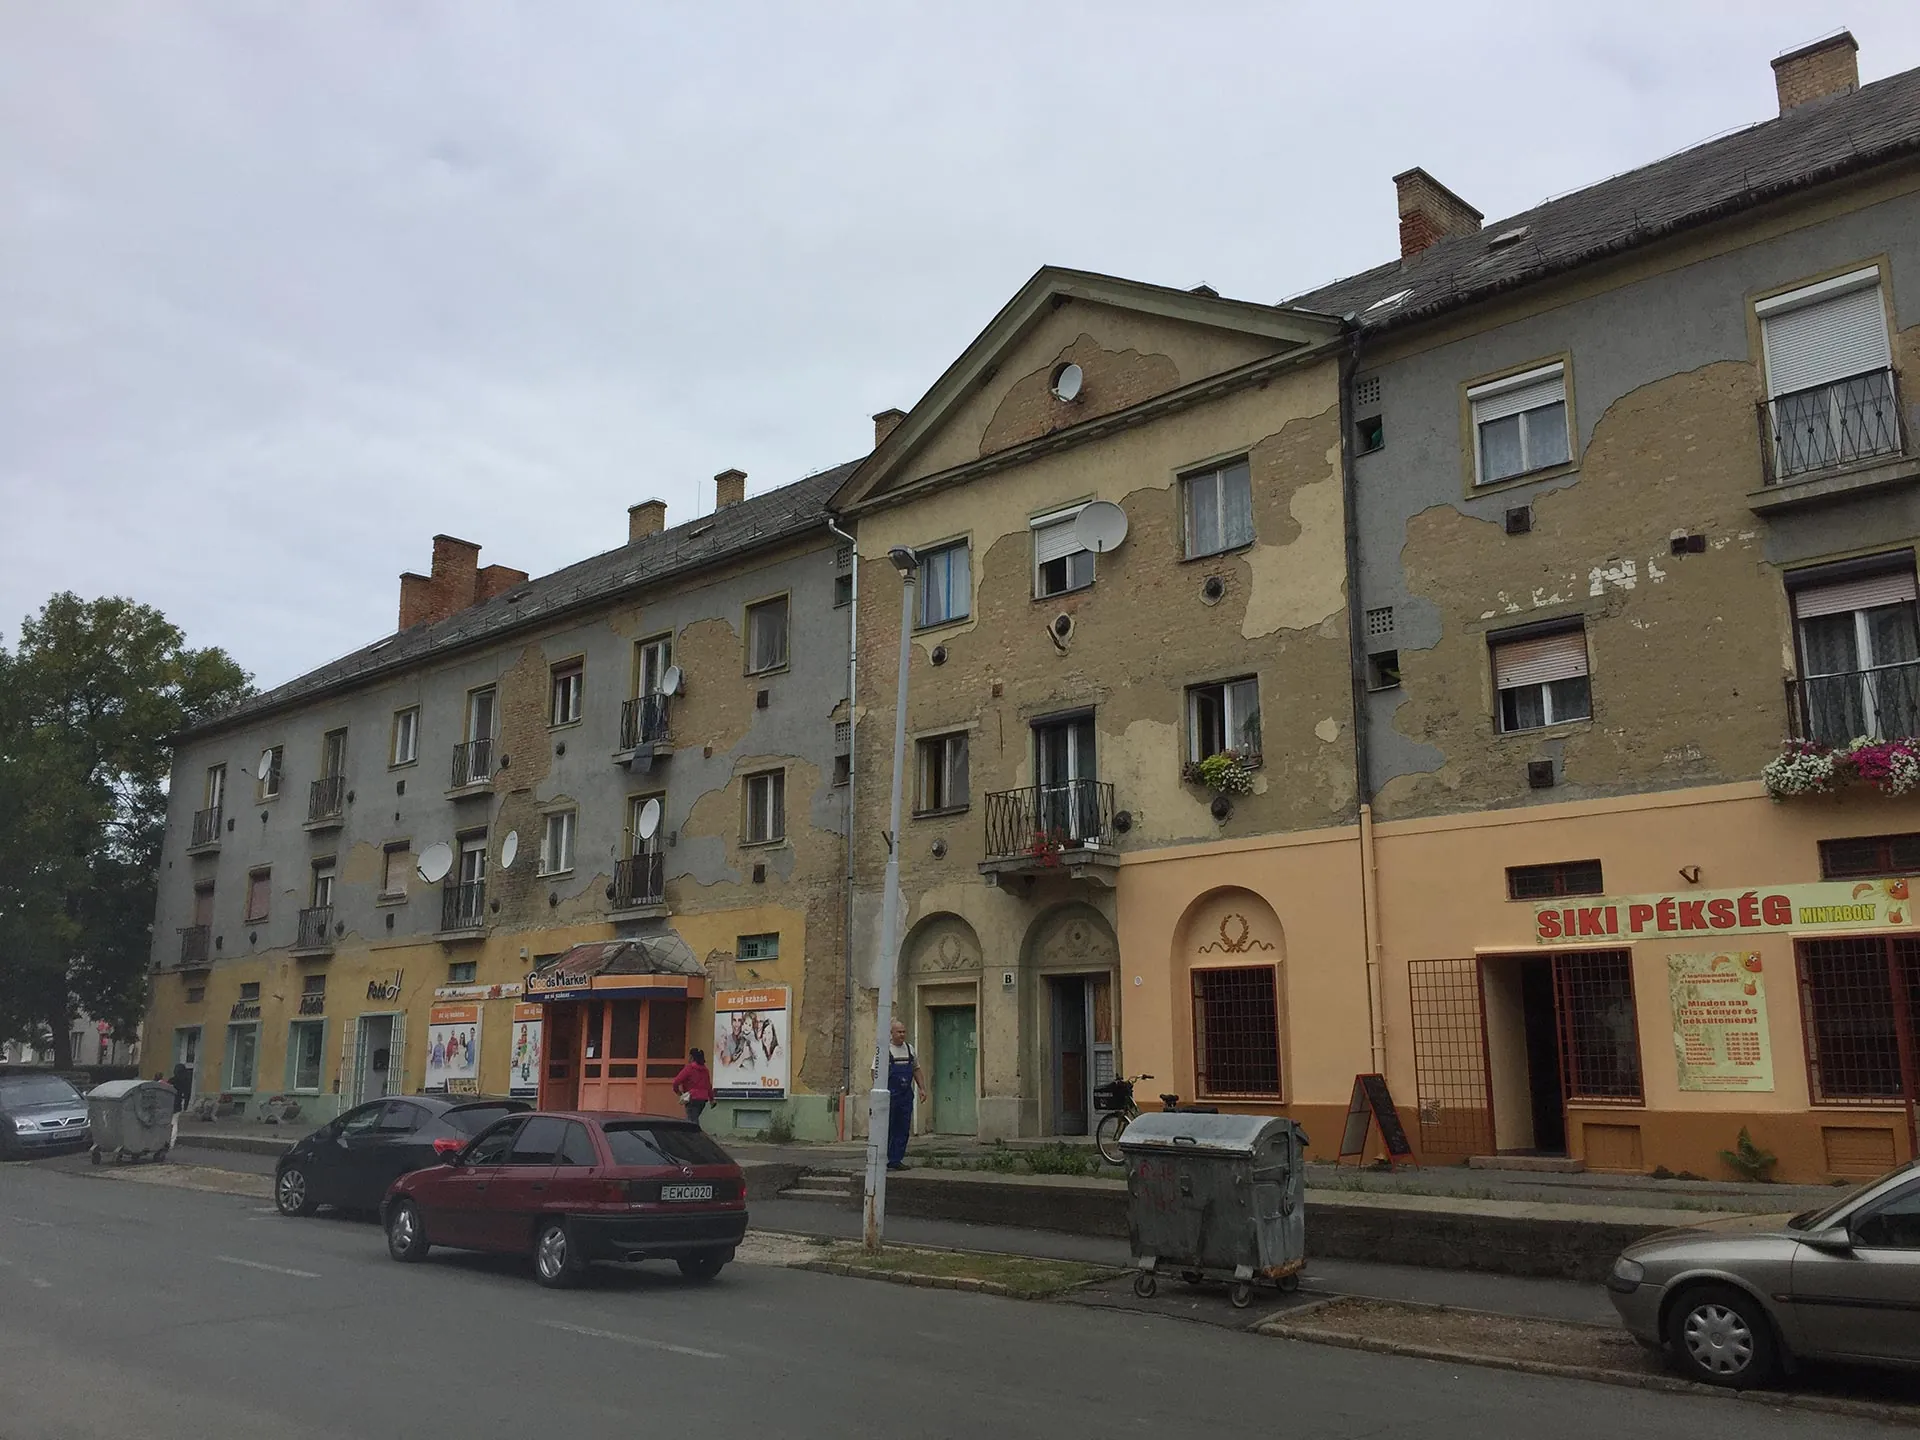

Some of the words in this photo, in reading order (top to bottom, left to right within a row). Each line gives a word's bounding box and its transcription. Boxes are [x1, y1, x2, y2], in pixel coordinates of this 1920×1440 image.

[1537, 905, 1618, 938] SIKI
[1629, 891, 1792, 933] PÉKSÉG
[1799, 904, 1876, 924] MINTABOLT
[1005, 974, 1012, 983] B
[761, 1076, 779, 1087] 100
